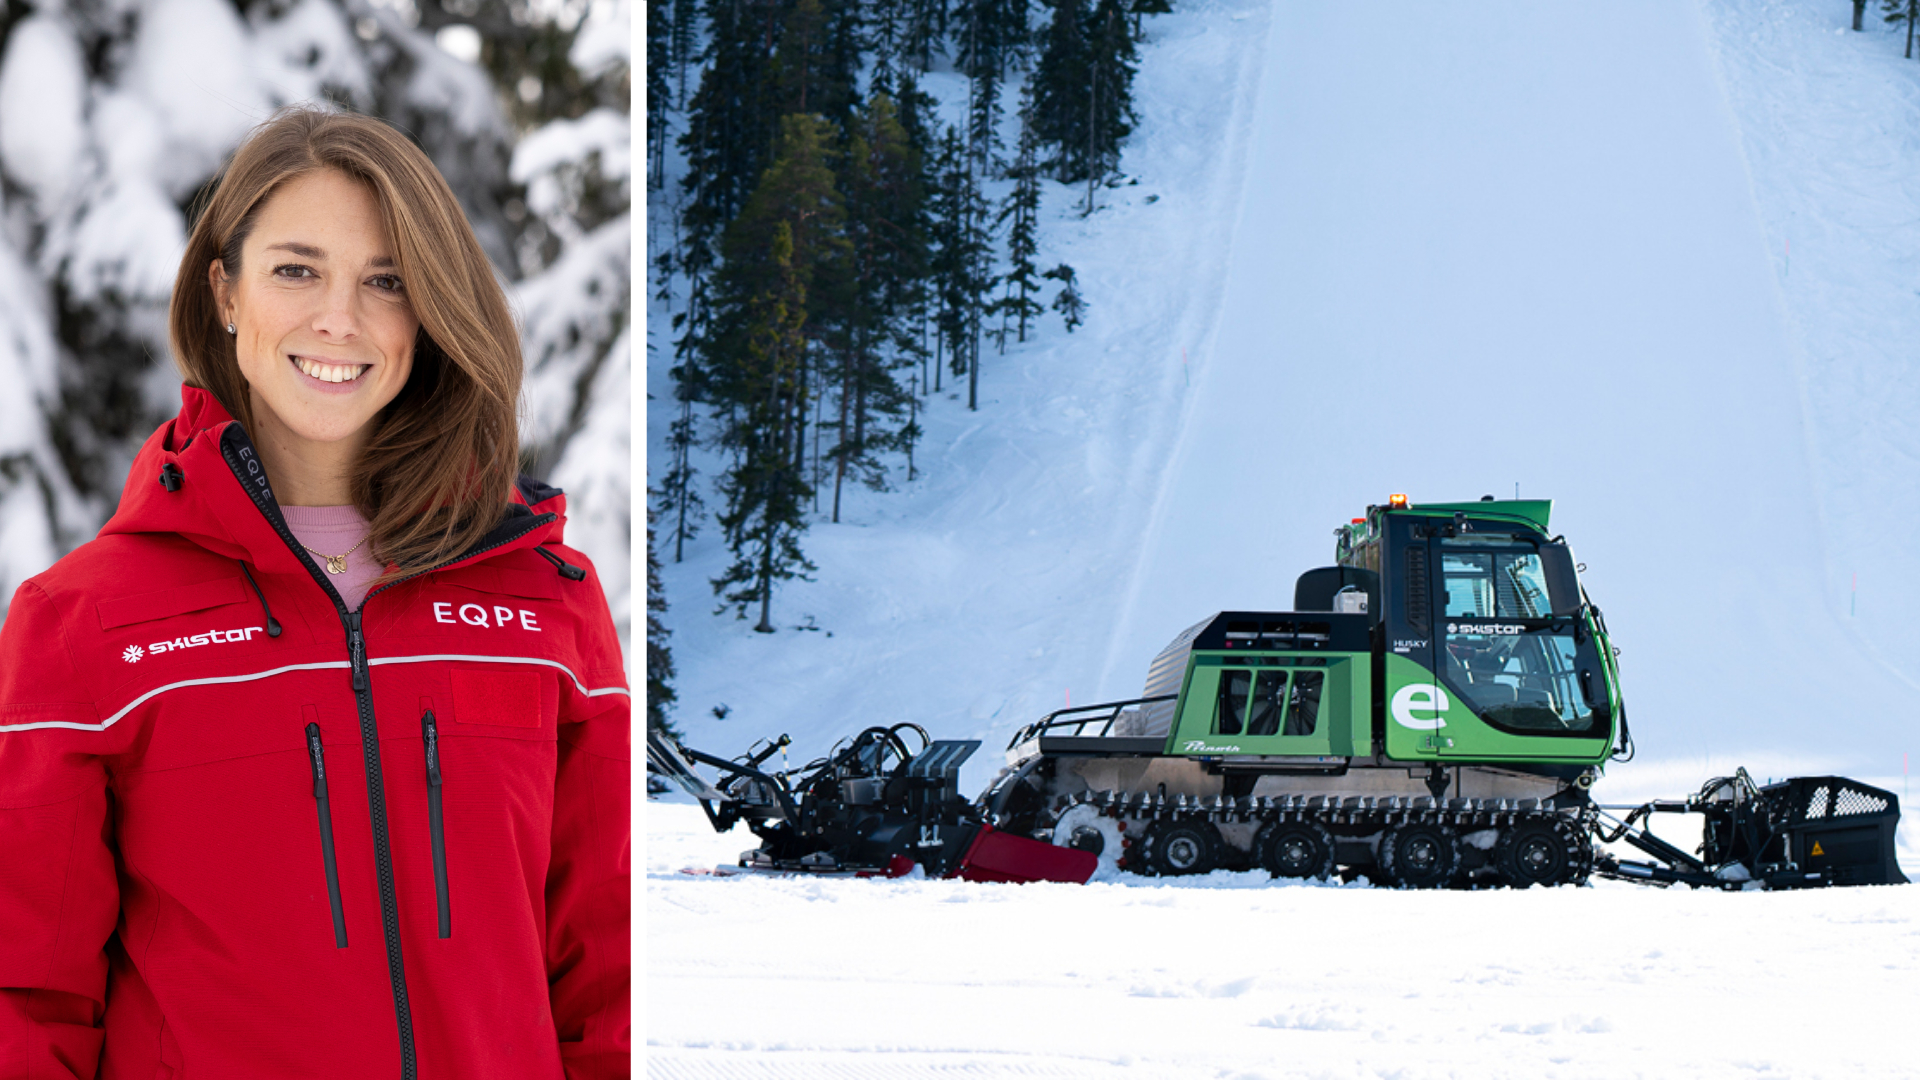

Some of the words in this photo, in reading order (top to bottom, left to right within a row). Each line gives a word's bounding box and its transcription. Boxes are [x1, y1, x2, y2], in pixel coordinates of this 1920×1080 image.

[238, 446, 272, 502] EQPE
[433, 602, 542, 632] EQPE
[1393, 639, 1428, 648] HUSKY
[1391, 683, 1449, 730] e
[1183, 740, 1241, 752] Prinoth
